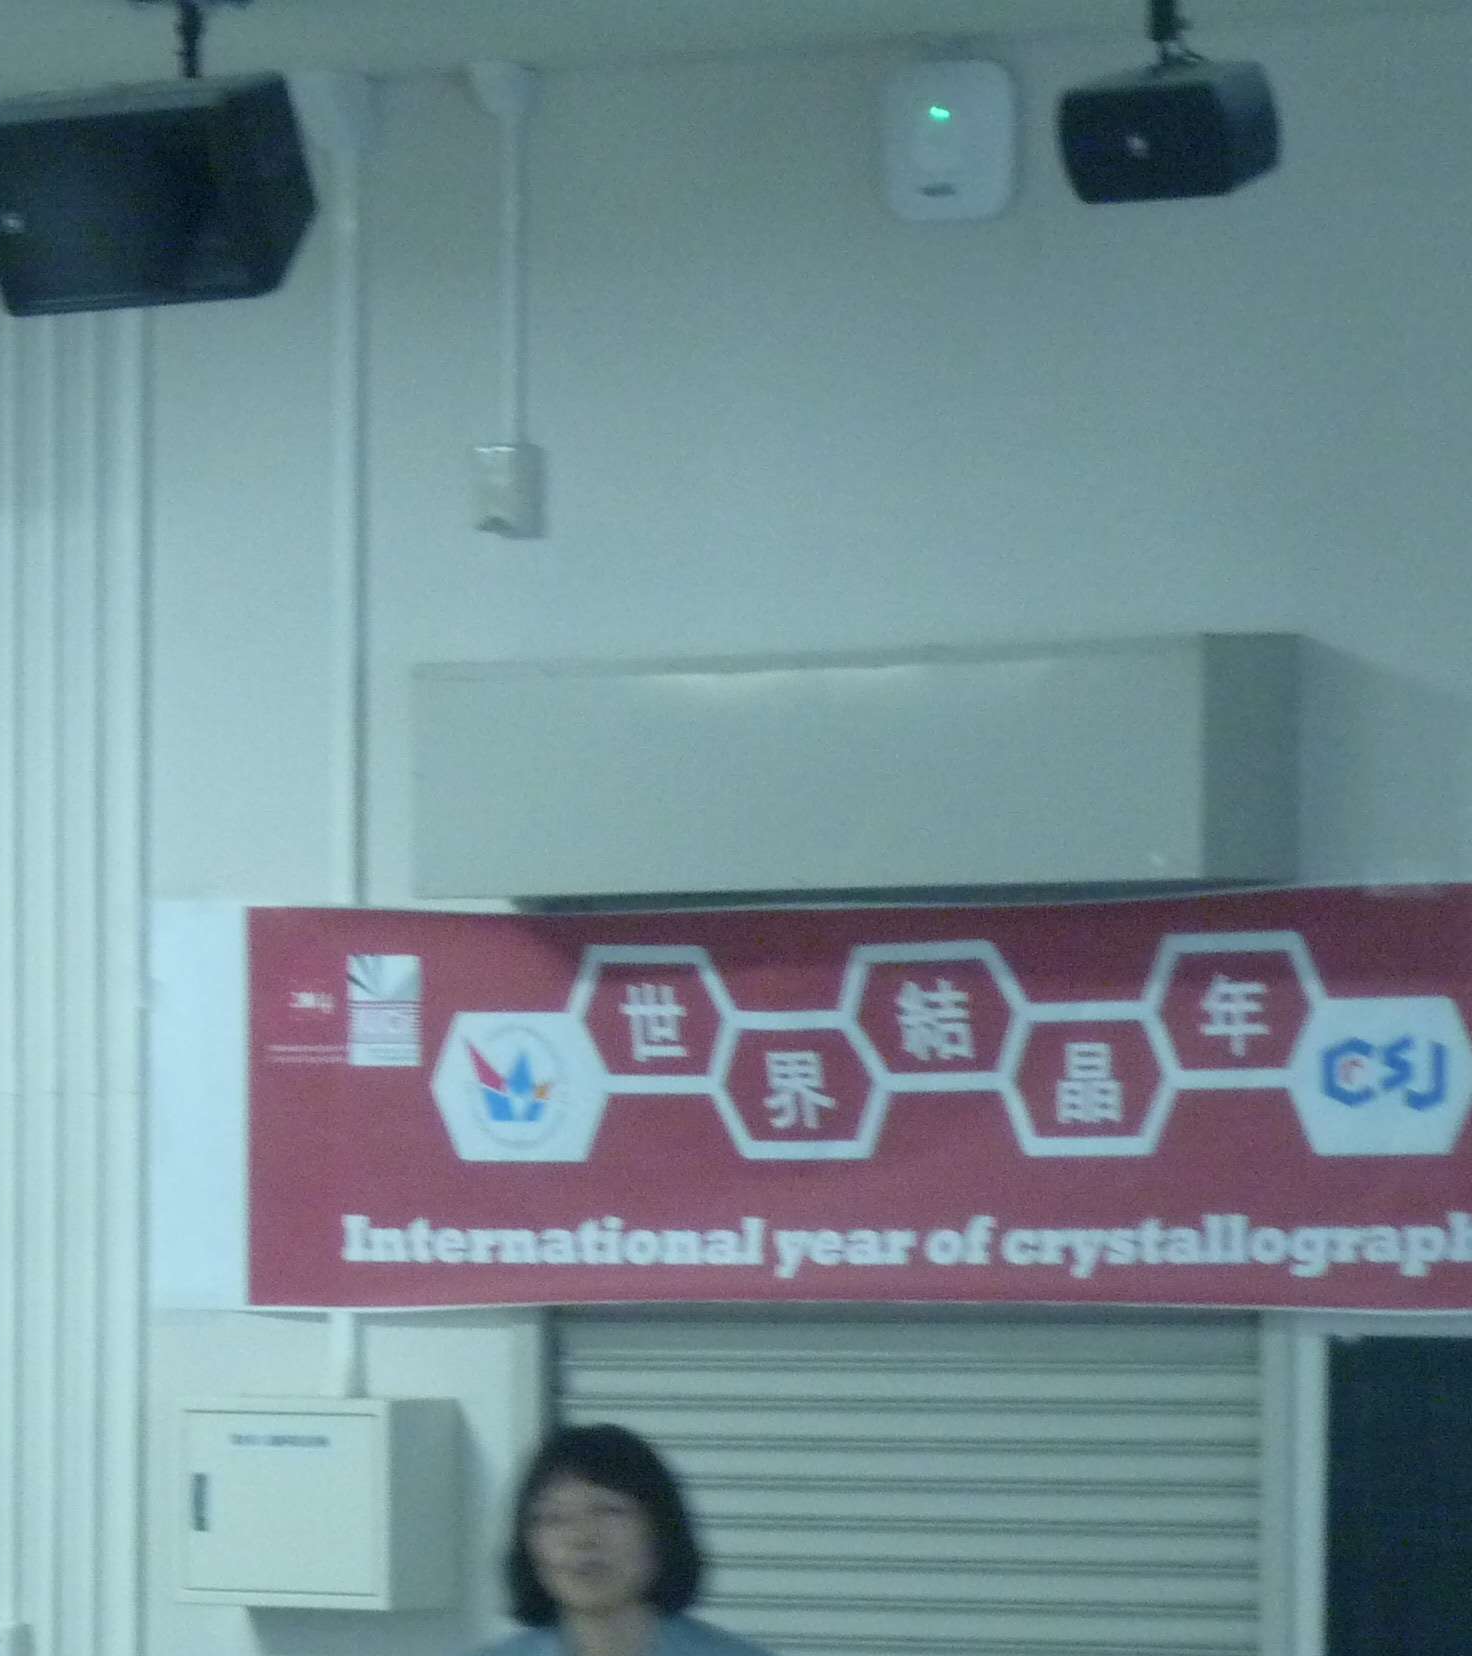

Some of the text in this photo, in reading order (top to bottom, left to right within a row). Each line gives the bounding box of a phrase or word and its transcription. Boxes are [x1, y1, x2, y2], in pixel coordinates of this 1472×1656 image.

[341, 1213, 766, 1266] International
[773, 1228, 917, 1280] year
[924, 1213, 999, 1266] of
